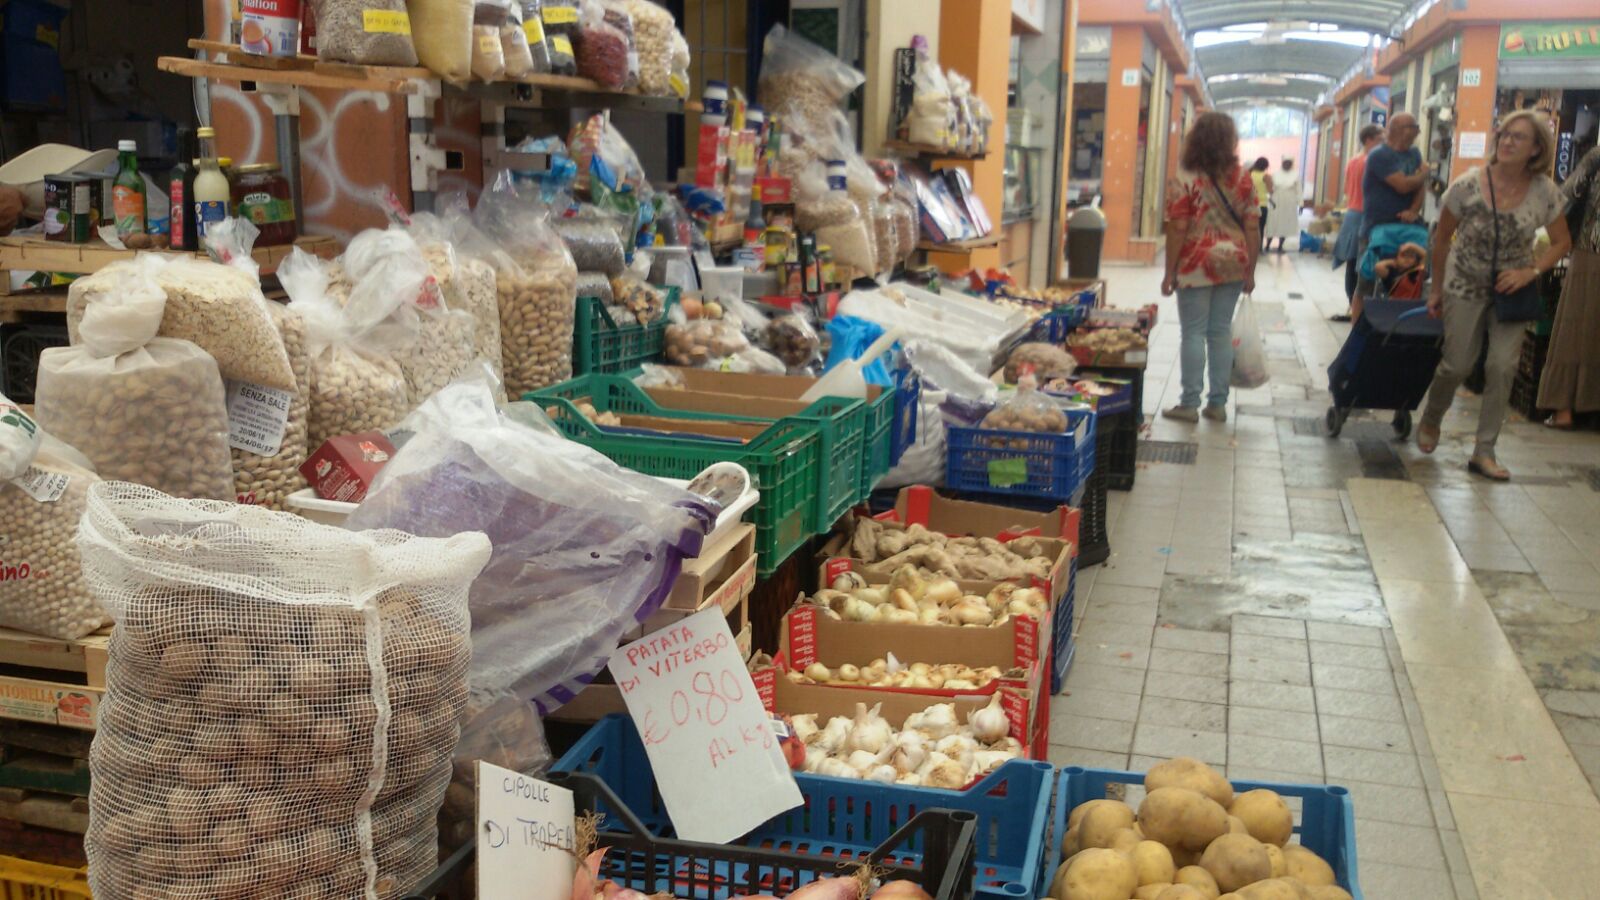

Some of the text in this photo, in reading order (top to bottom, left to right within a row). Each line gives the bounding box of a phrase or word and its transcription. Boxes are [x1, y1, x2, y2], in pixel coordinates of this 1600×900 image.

[240, 386, 266, 404] SENZA
[267, 396, 287, 412] SALE
[621, 632, 729, 694] DI VITERBO
[626, 625, 694, 666] PATATA
[503, 776, 550, 803] CIPOLLE
[485, 817, 573, 852] DI TROPEA
